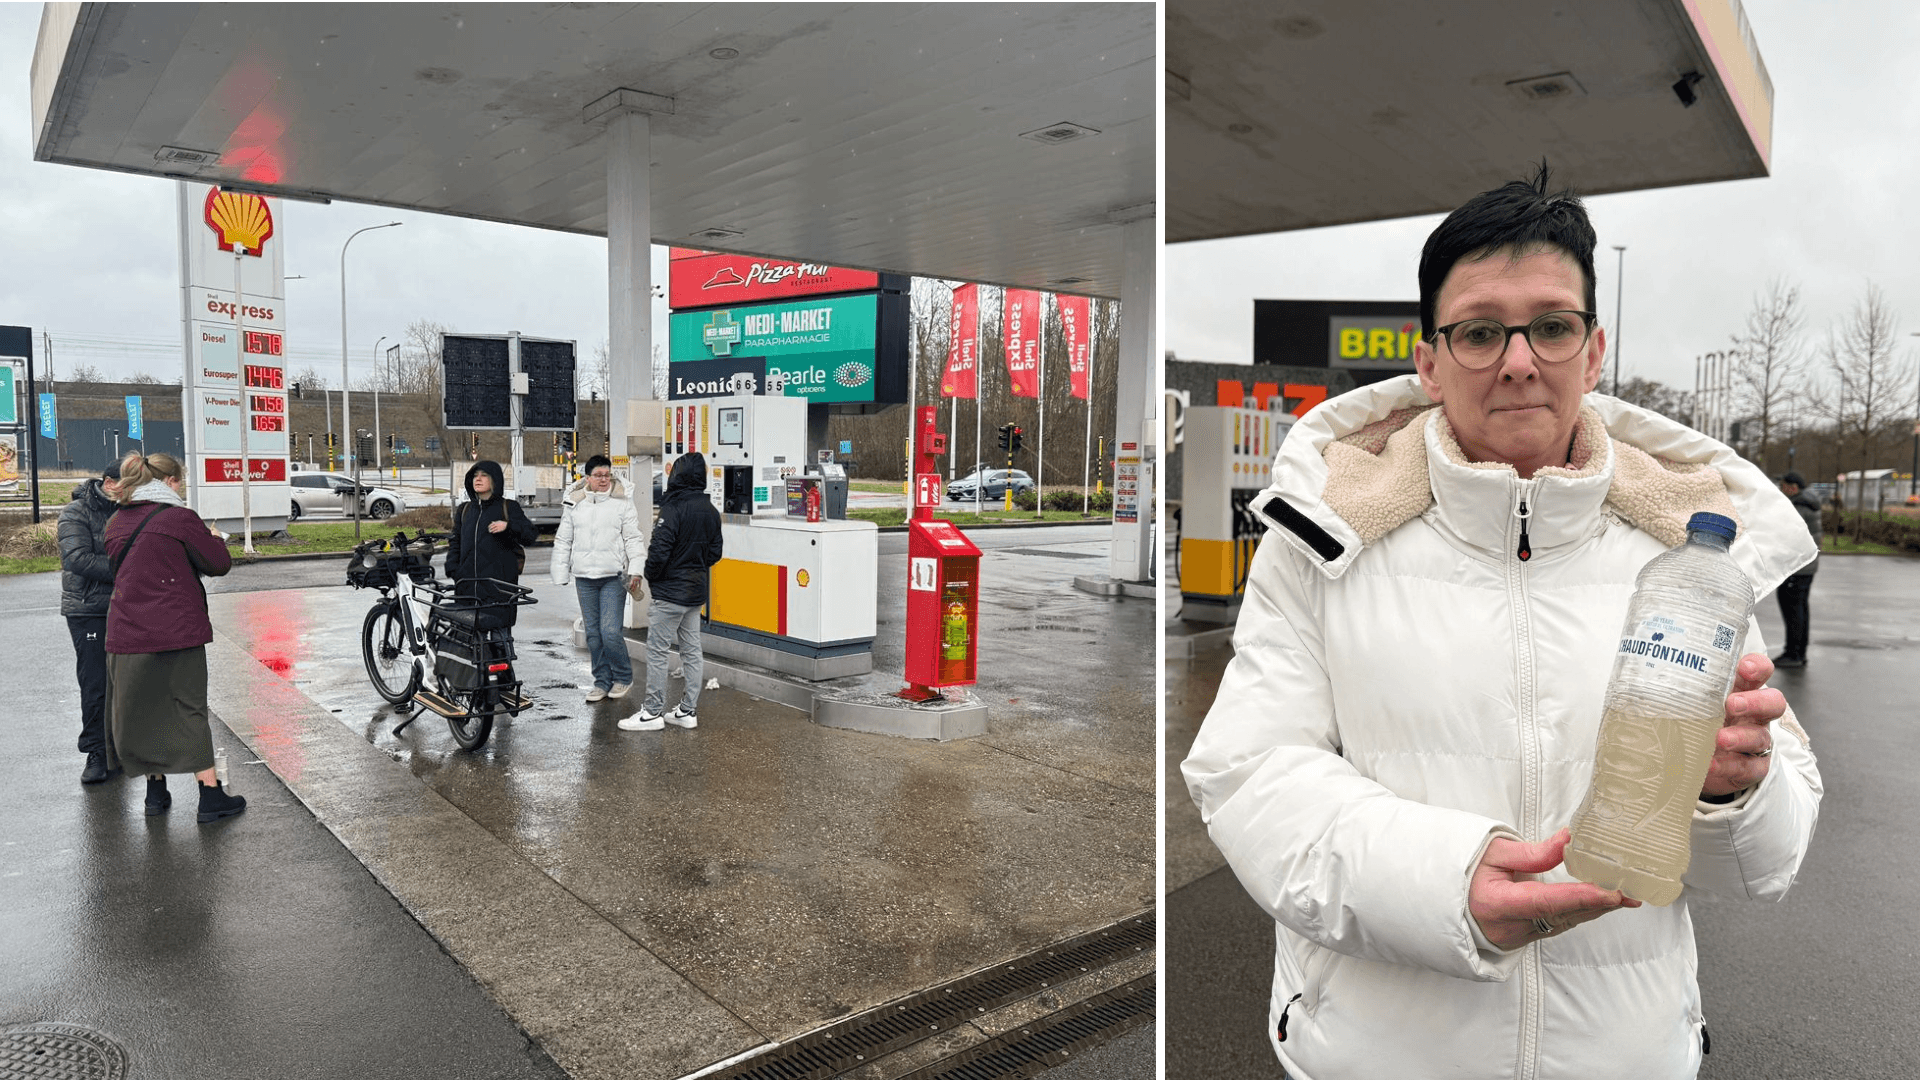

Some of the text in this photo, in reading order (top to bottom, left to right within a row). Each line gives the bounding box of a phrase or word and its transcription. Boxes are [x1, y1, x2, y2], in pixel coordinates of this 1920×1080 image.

[745, 262, 795, 288] Pizza
[202, 332, 226, 344] Diesel
[744, 333, 831, 348] PARAPHARMACIE
[1339, 323, 1422, 360] BRI
[203, 367, 238, 381] Eurosuper
[676, 375, 758, 395] Leonids
[204, 396, 229, 405] V-Power
[205, 416, 230, 426] V-Power
[223, 469, 267, 479] V-Pwer
